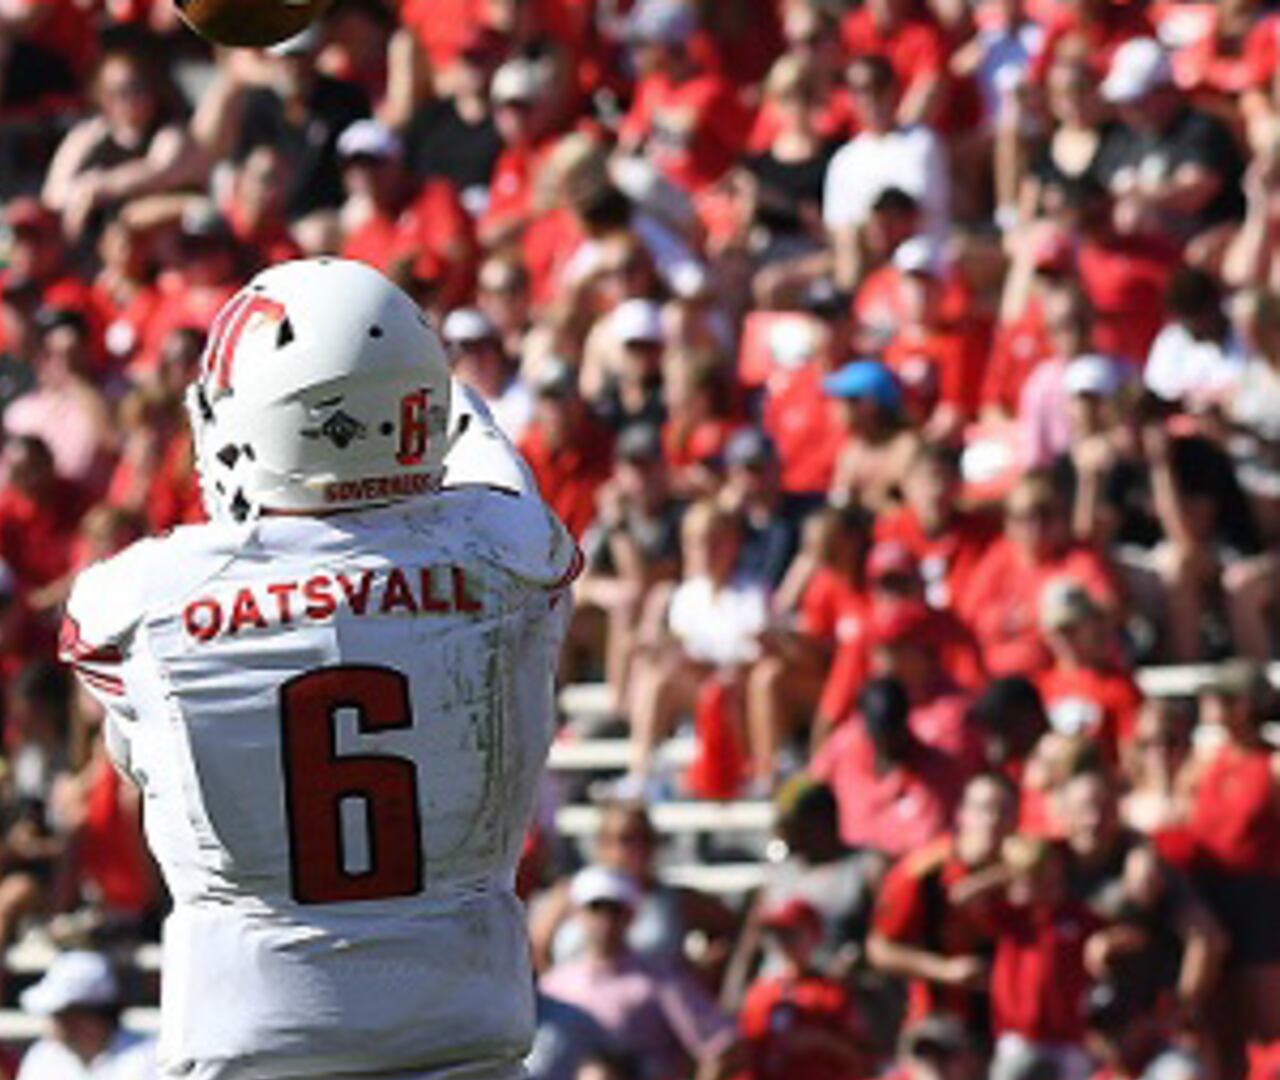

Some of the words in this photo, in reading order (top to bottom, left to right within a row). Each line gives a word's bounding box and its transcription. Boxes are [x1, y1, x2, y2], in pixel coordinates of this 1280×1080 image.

[396, 387, 428, 466] 6
[182, 565, 483, 643] OATSVALL
[280, 663, 424, 904] 6
